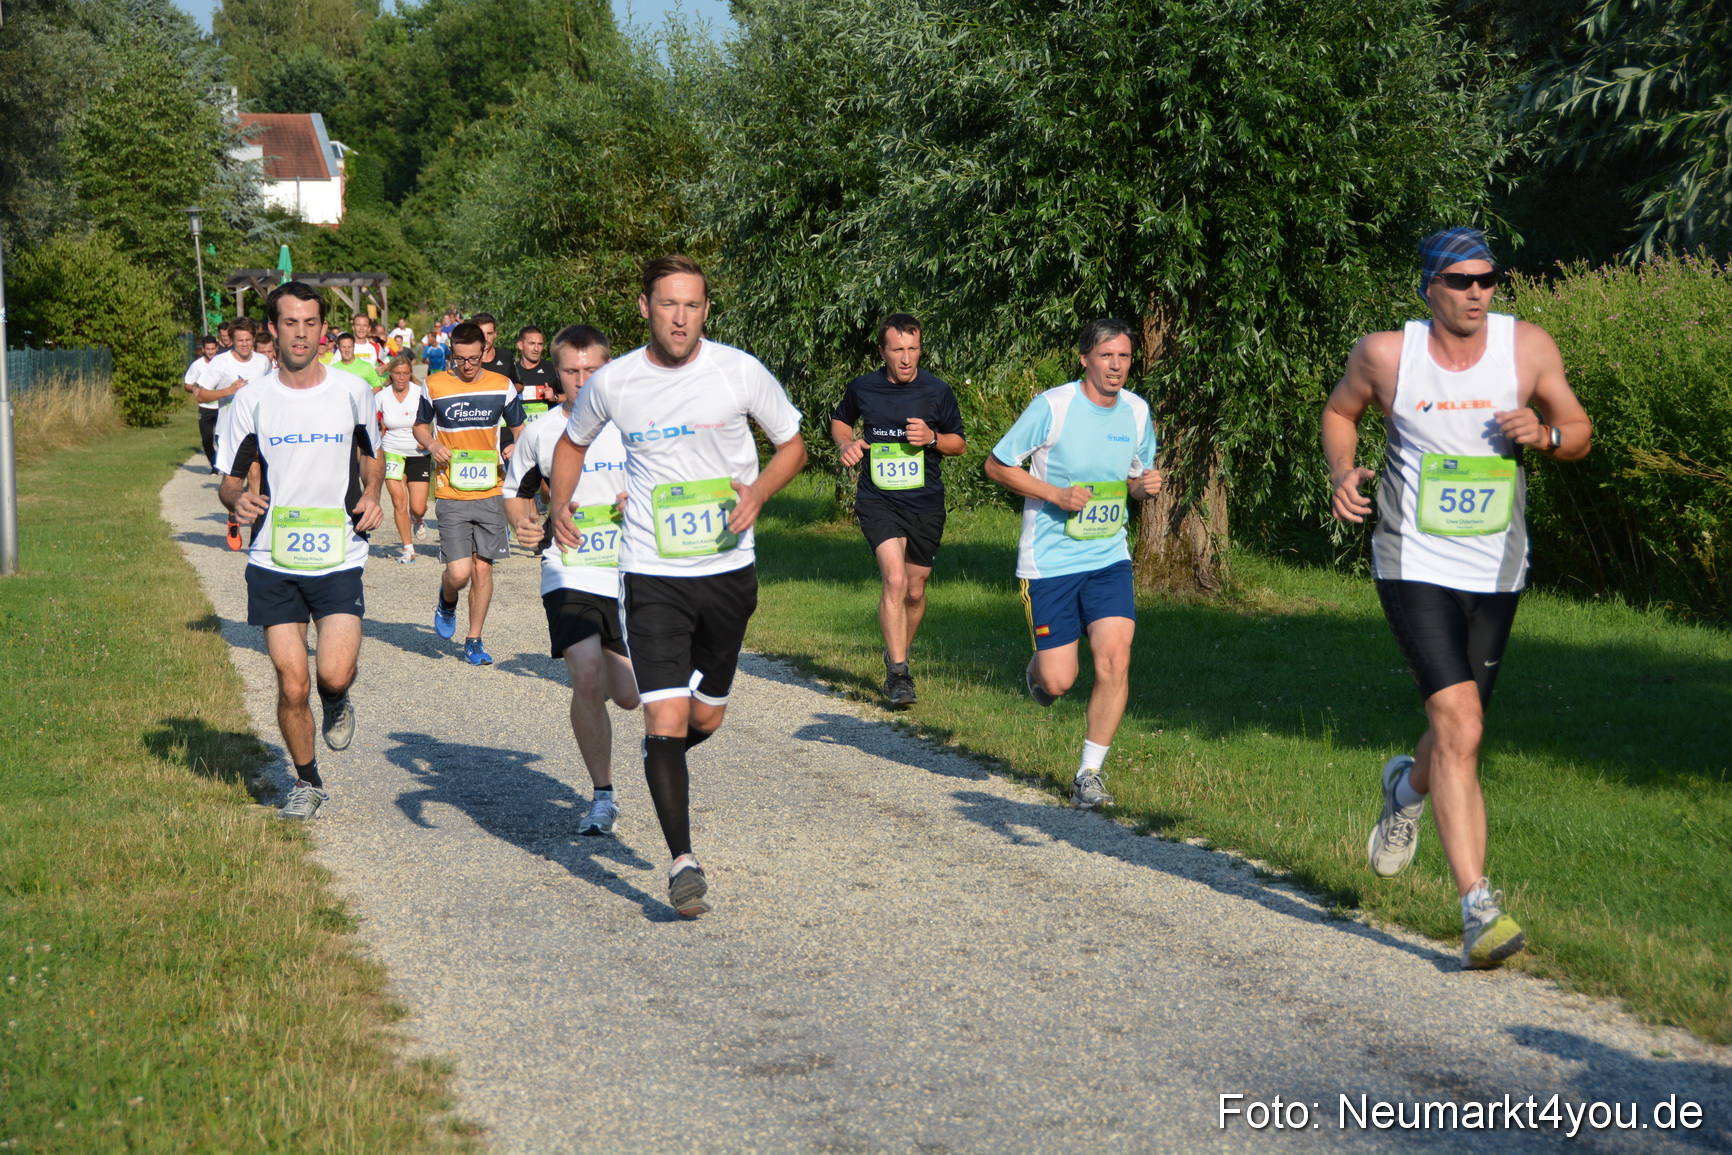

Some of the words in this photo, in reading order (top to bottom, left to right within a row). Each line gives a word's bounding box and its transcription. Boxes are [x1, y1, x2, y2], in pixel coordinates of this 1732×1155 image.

[1437, 400, 1497, 410] KLEBL
[454, 408, 492, 418] Fischer
[873, 428, 888, 436] Seitz
[269, 433, 344, 446] DELPHI
[386, 462, 398, 471] 57
[459, 466, 488, 479] 404
[877, 461, 919, 477] 1319
[1439, 488, 1495, 513] 587
[1079, 504, 1120, 524] 1430
[665, 507, 727, 536] 1311
[287, 532, 331, 553] 283
[577, 530, 618, 553] 267
